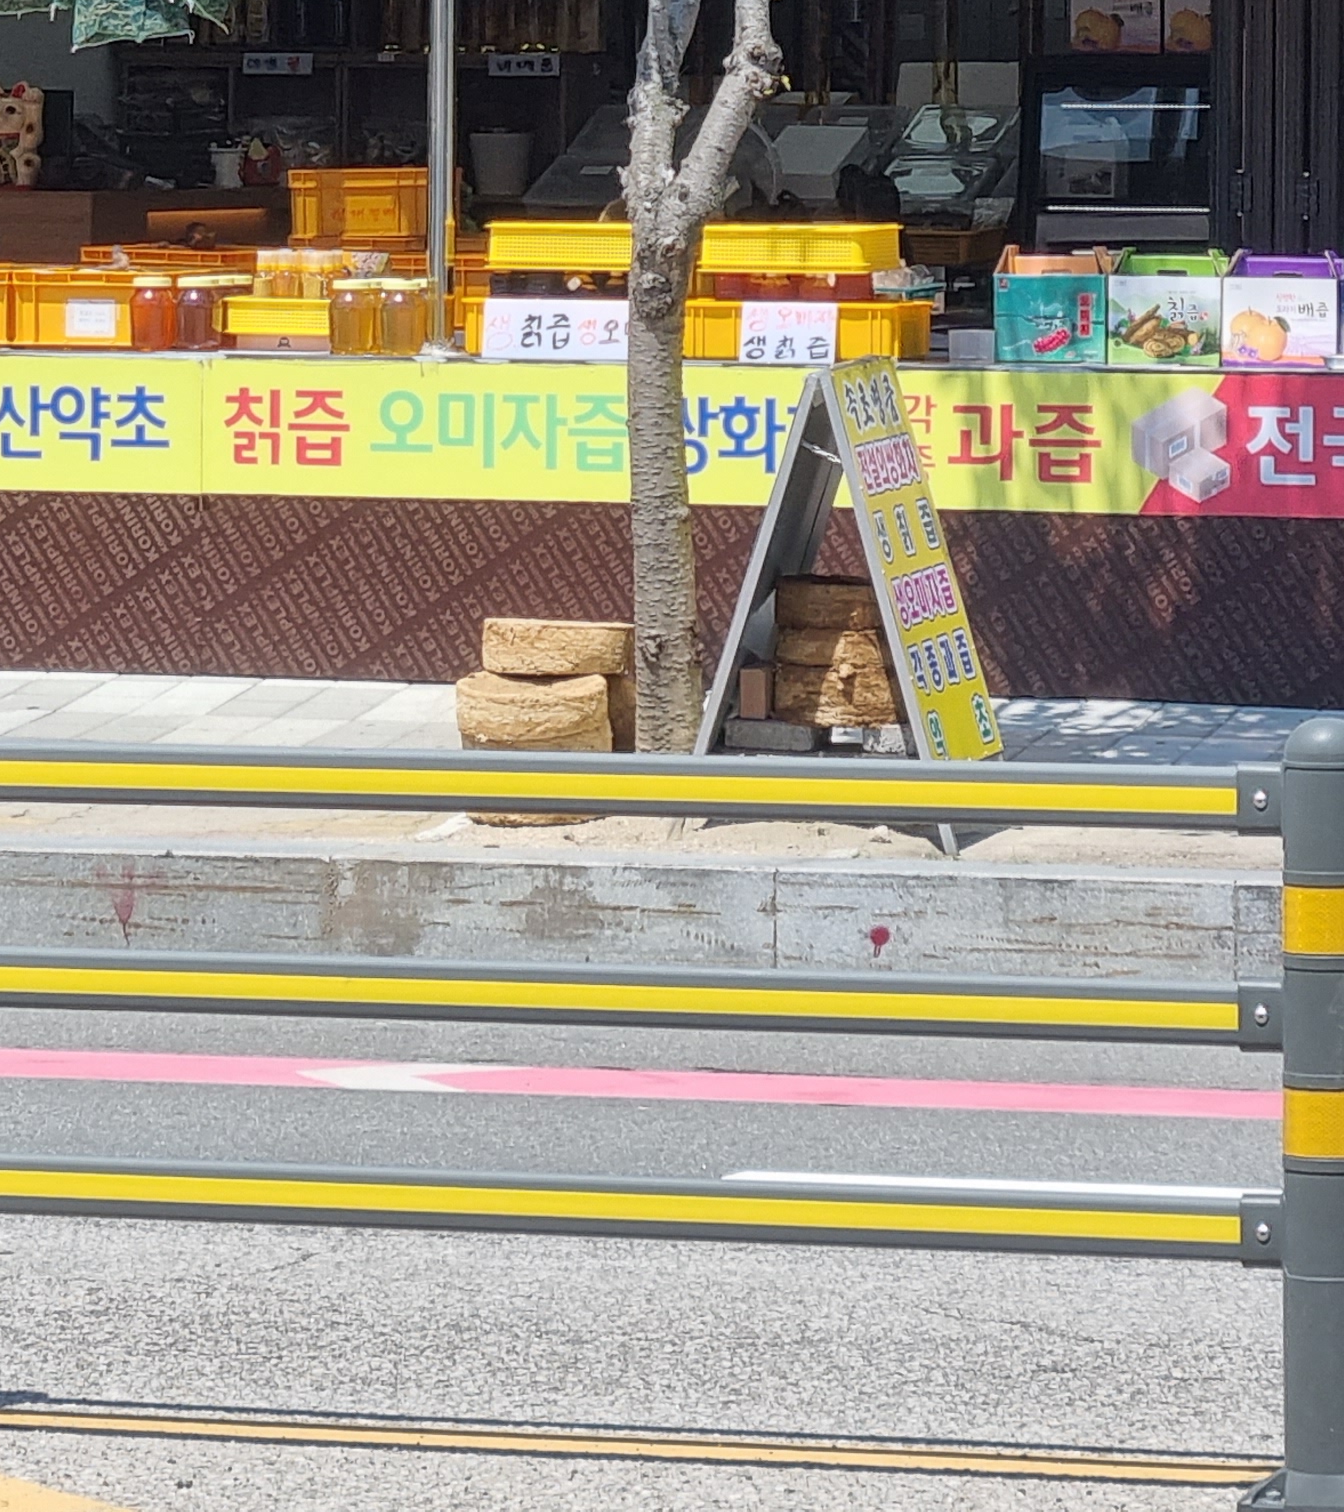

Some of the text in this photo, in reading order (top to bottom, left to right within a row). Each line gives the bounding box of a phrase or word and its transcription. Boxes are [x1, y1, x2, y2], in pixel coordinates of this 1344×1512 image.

[1298, 302, 1329, 318] 배즙
[224, 387, 351, 467] 칡즙
[370, 389, 629, 471] 오미자즙
[947, 403, 1103, 483] 과즙
[892, 563, 957, 630] 생오미자즙
[908, 628, 975, 694] 각종과즙
